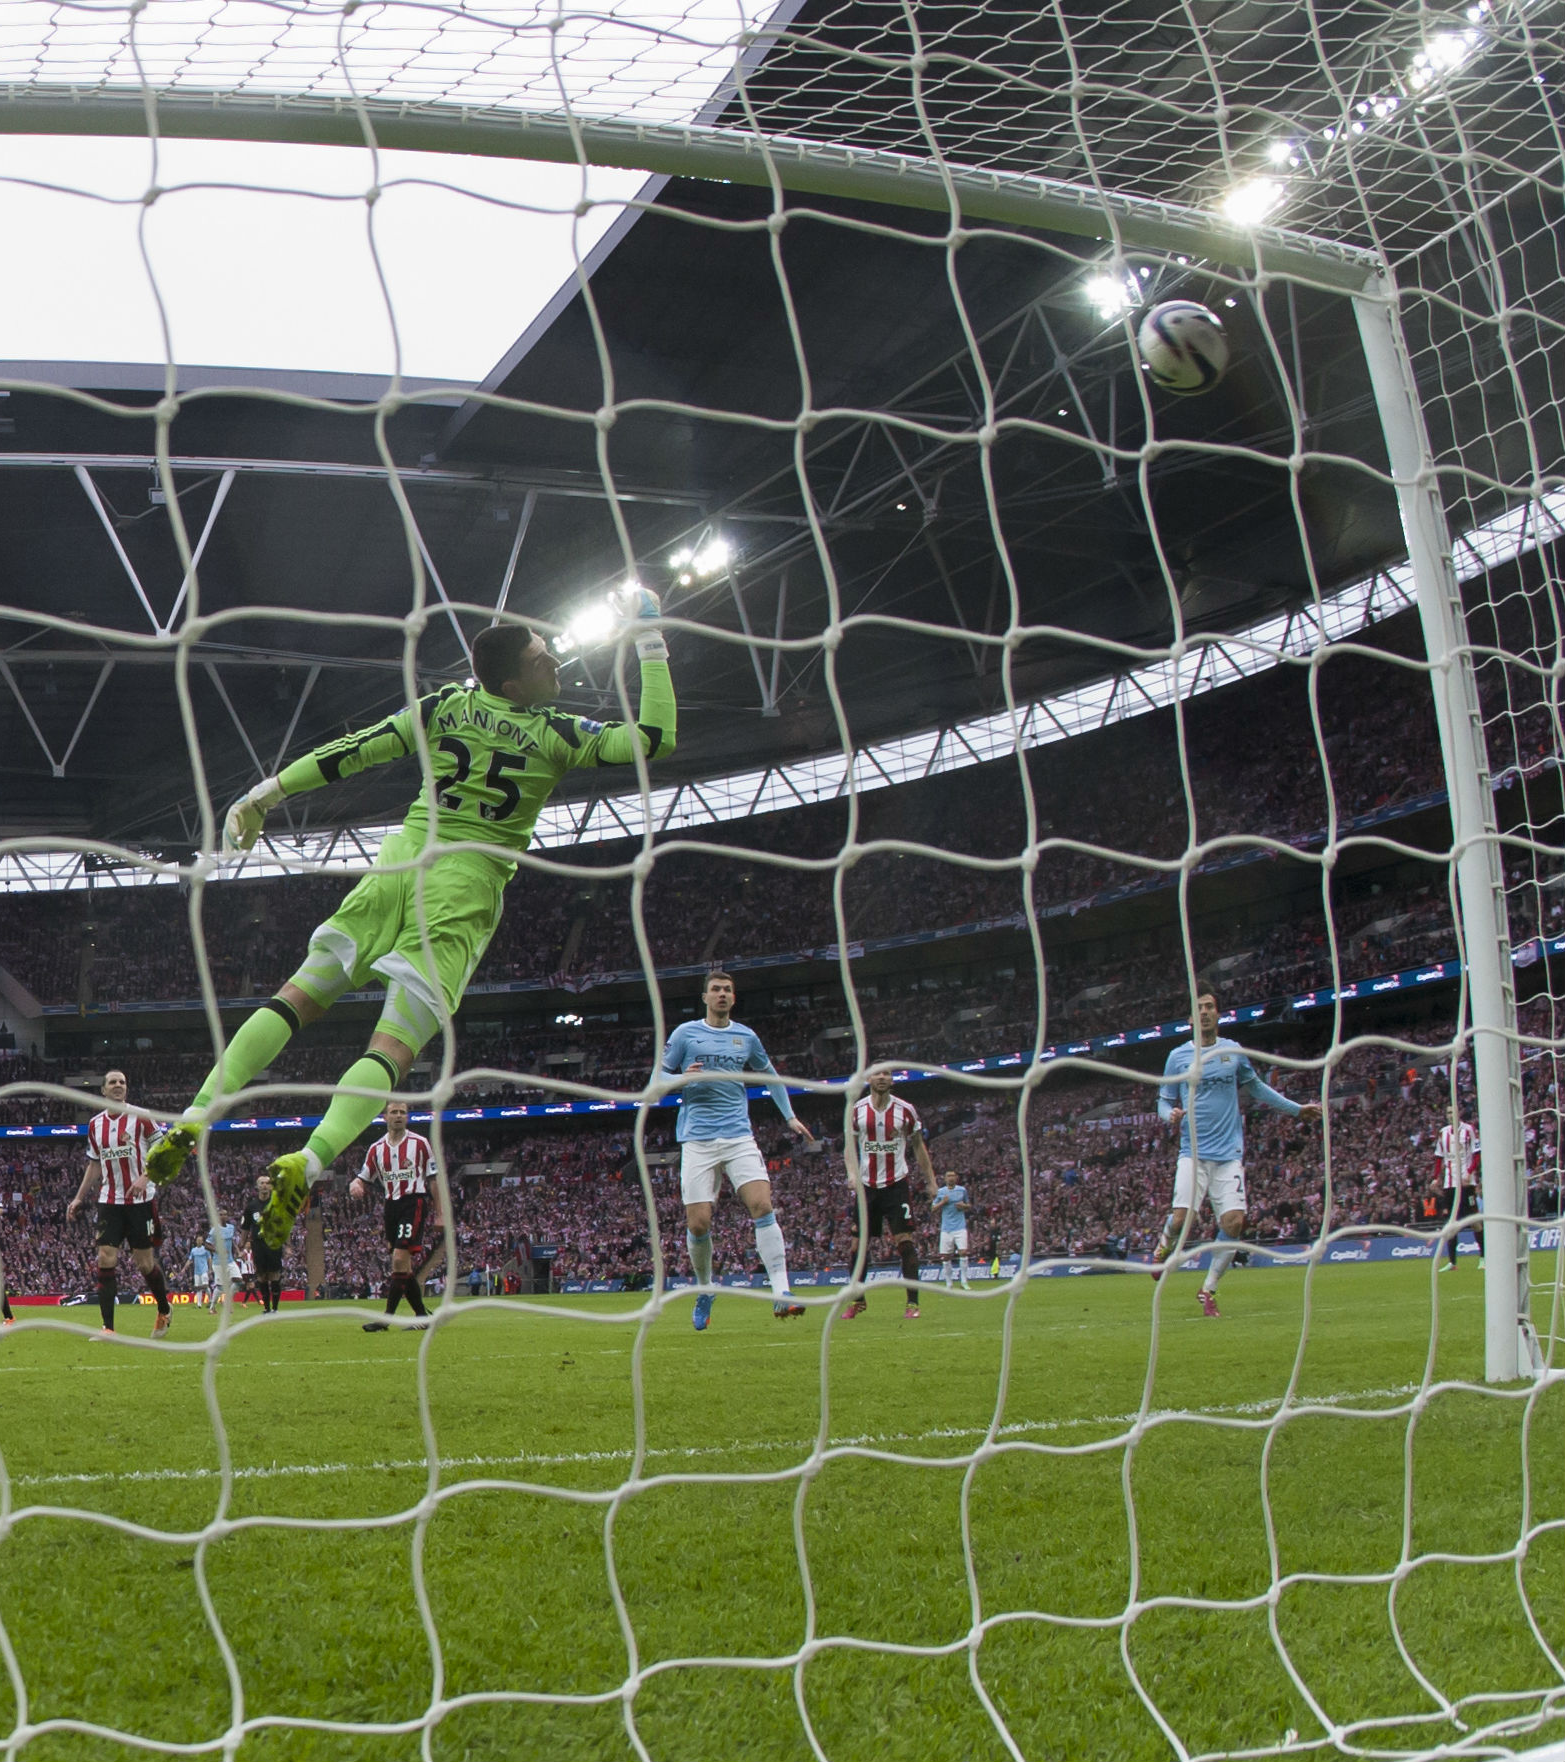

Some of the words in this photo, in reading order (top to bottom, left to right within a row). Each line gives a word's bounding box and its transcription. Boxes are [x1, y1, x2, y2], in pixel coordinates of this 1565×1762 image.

[435, 736, 527, 821] 25
[695, 1054, 744, 1066] ETIHAD
[864, 1142, 899, 1152] Bidvest
[901, 1203, 912, 1219] 2
[397, 1223, 413, 1239] 33
[1457, 1241, 1481, 1253] Capita
